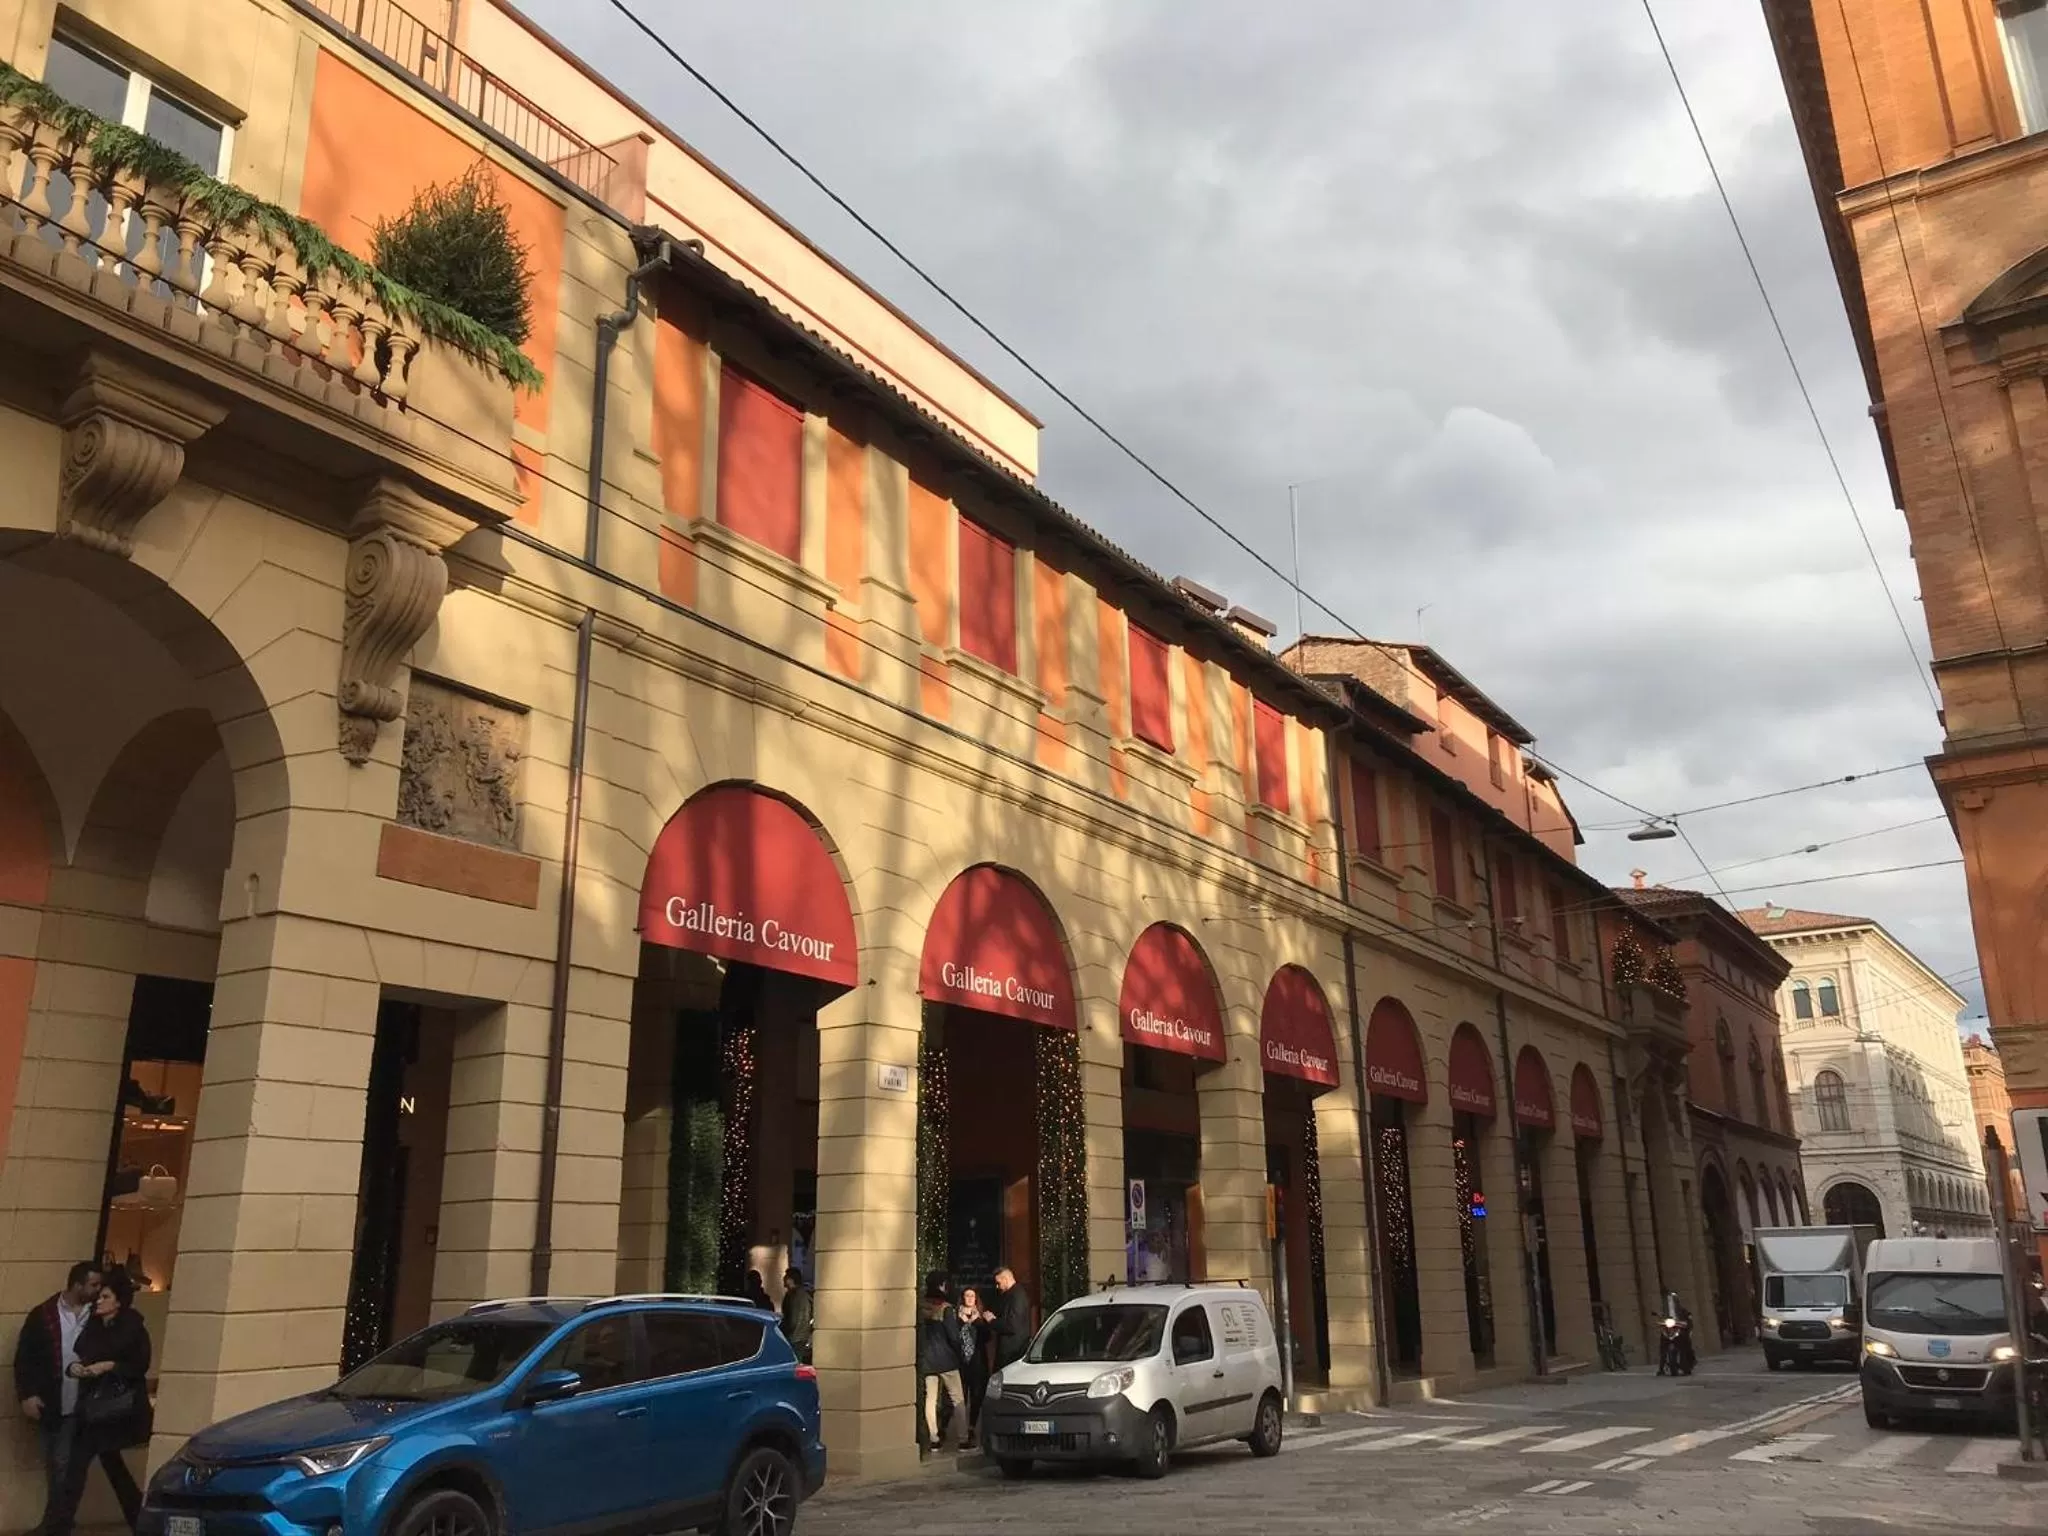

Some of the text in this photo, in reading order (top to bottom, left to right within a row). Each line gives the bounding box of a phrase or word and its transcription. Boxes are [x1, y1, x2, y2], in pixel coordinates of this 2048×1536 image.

[666, 896, 835, 962] Galleria Cavour
[941, 961, 1055, 1010] Galleria Cavour
[1130, 1007, 1212, 1046] Galleria Cavour
[1266, 1039, 1329, 1072] Galleria Cavour
